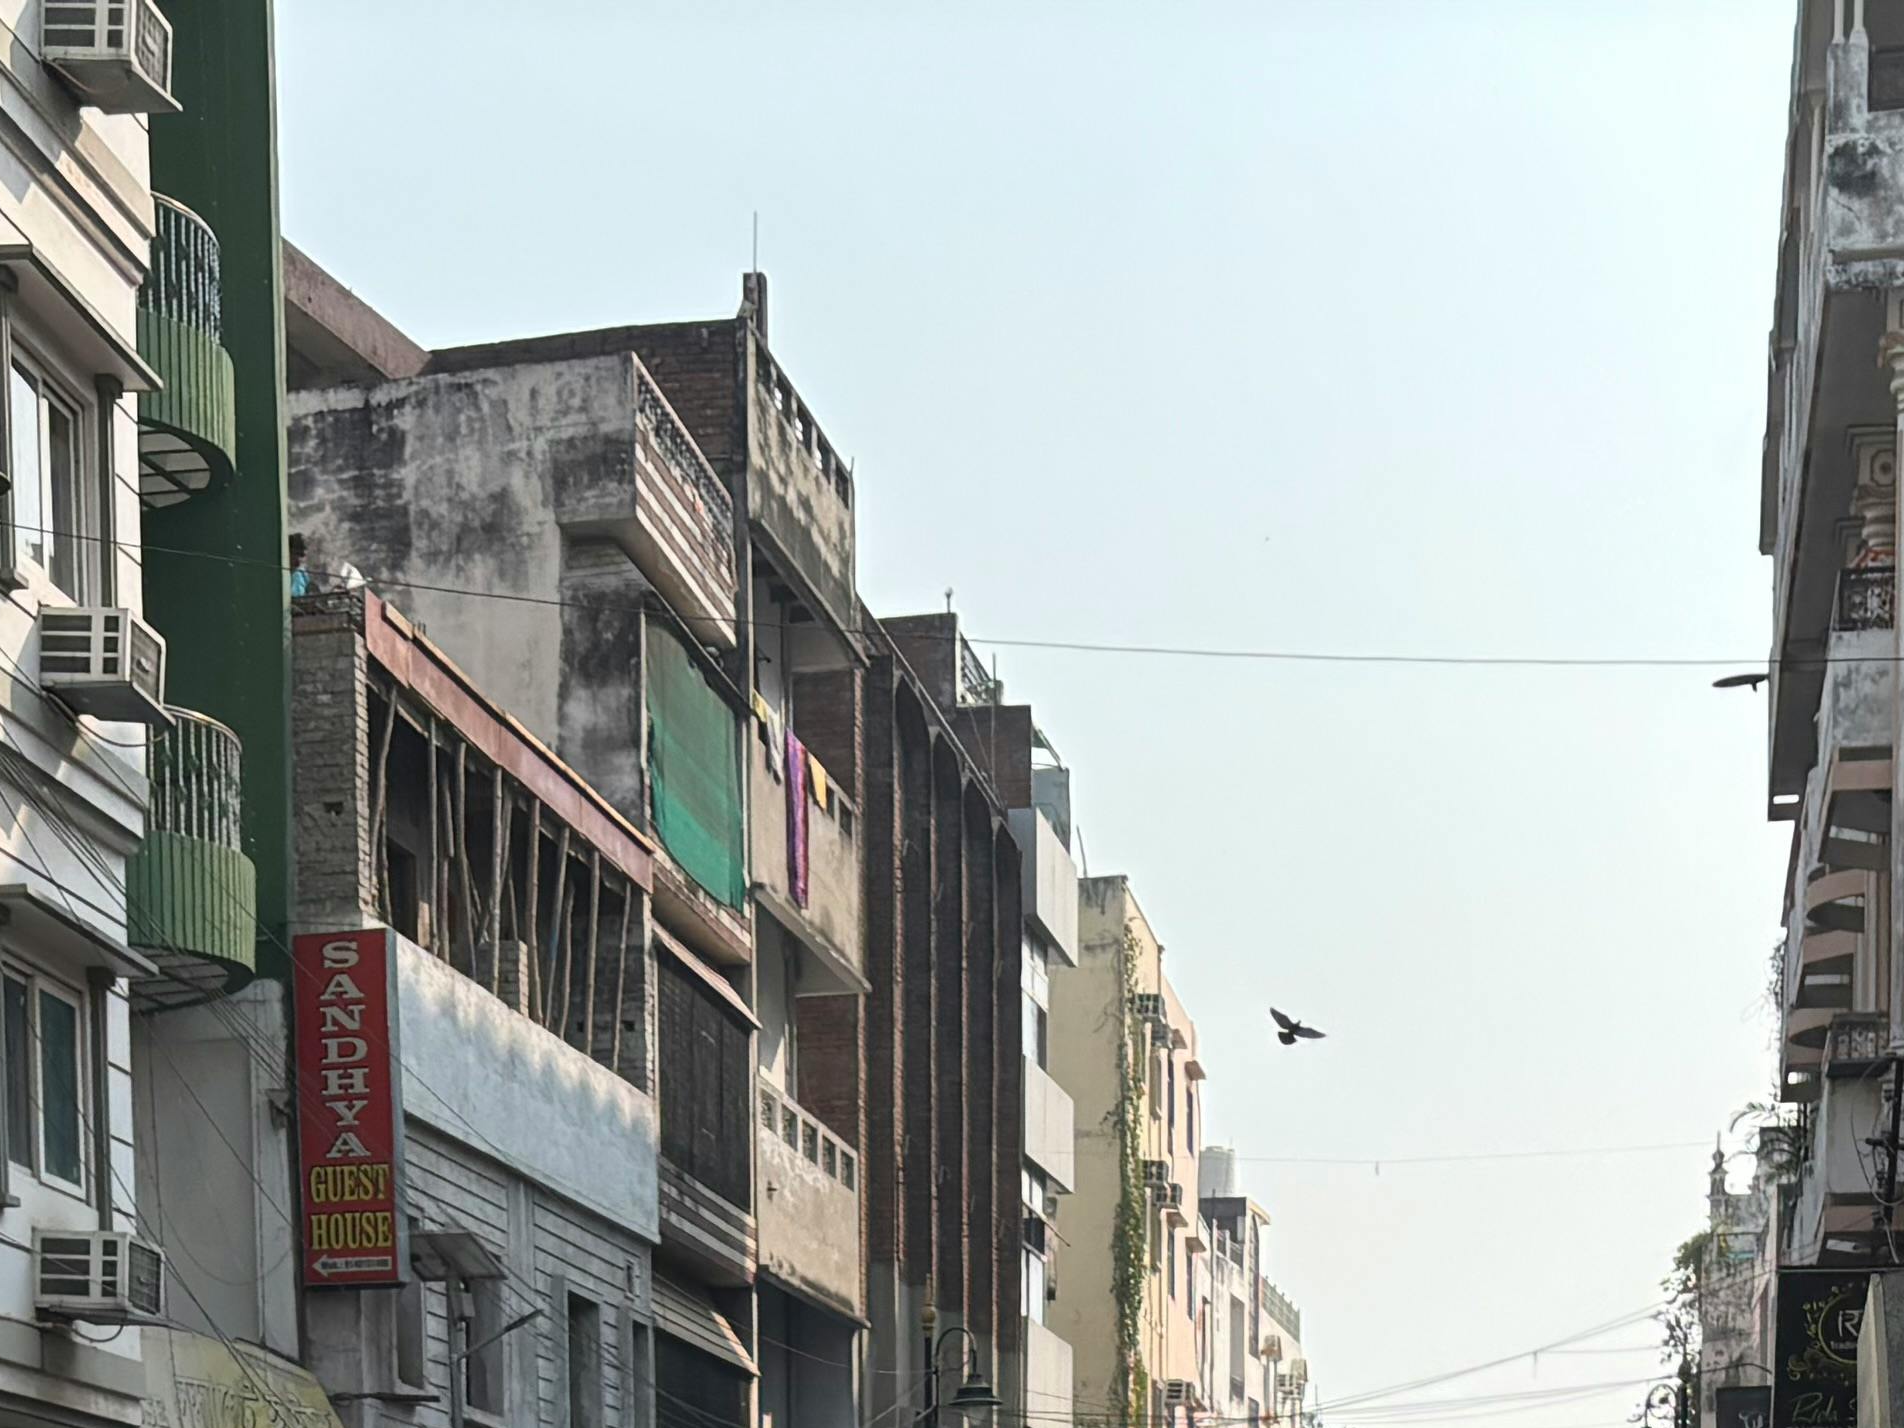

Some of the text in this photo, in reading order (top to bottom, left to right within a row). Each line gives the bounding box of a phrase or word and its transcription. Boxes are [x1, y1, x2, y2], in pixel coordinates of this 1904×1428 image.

[320, 941, 371, 1158] SANDHYA
[311, 1165, 388, 1202] GUEST
[311, 1211, 391, 1250] HOUSE
